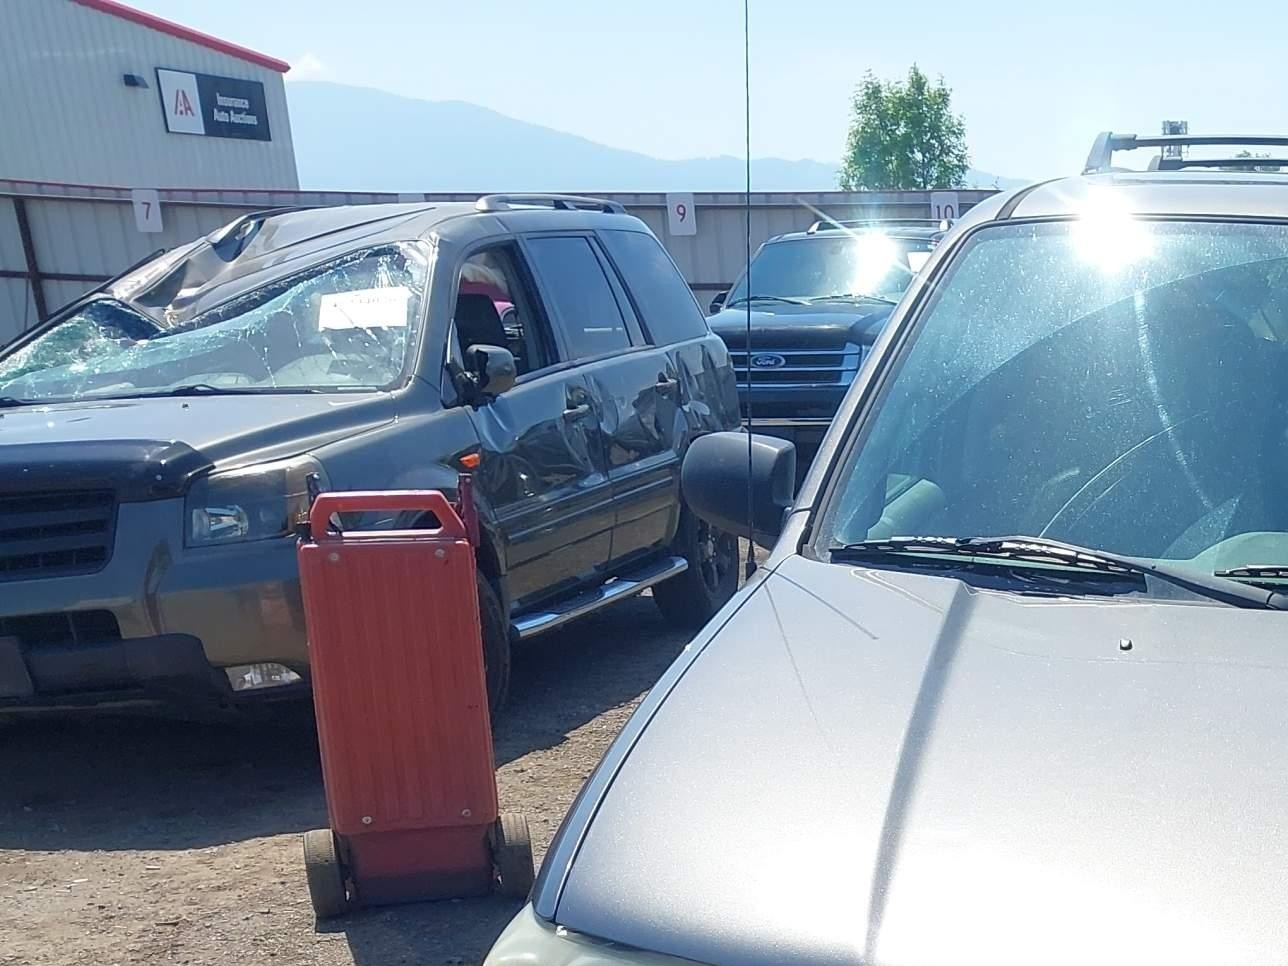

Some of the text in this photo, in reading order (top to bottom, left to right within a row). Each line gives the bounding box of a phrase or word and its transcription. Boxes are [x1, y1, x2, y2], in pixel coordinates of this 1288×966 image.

[141, 201, 151, 220] 7
[676, 203, 687, 222] 9
[936, 204, 954, 219] 10
